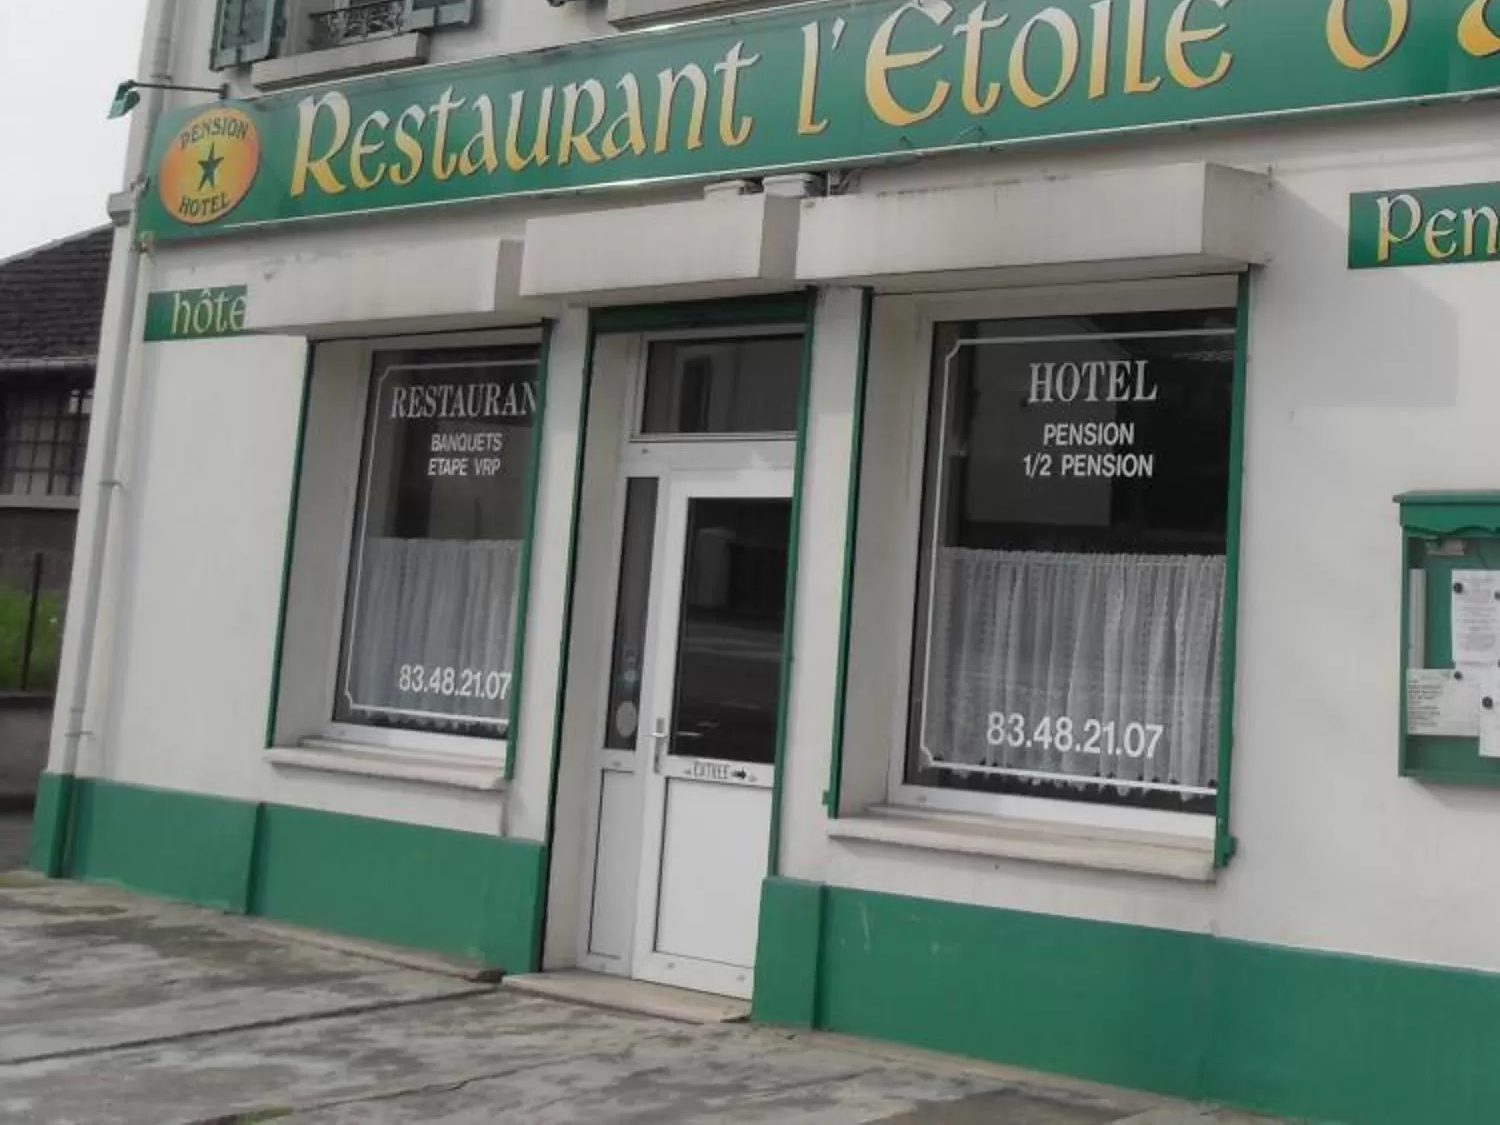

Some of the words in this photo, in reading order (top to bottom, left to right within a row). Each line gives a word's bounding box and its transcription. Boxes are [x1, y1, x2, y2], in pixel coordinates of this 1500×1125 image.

[180, 116, 249, 149] PENSION
[179, 192, 228, 217] HOTEL
[1027, 360, 1158, 404] HOTEL
[431, 432, 504, 452] BANQUETS
[1043, 423, 1134, 446] PENSION
[428, 457, 469, 475] ETAPE
[473, 457, 501, 475] VRP
[1023, 454, 1052, 477] 1/2
[1061, 454, 1153, 478] PENSION
[398, 665, 512, 700] 83.48.21.07
[986, 713, 1163, 759] 83.48.21.07
